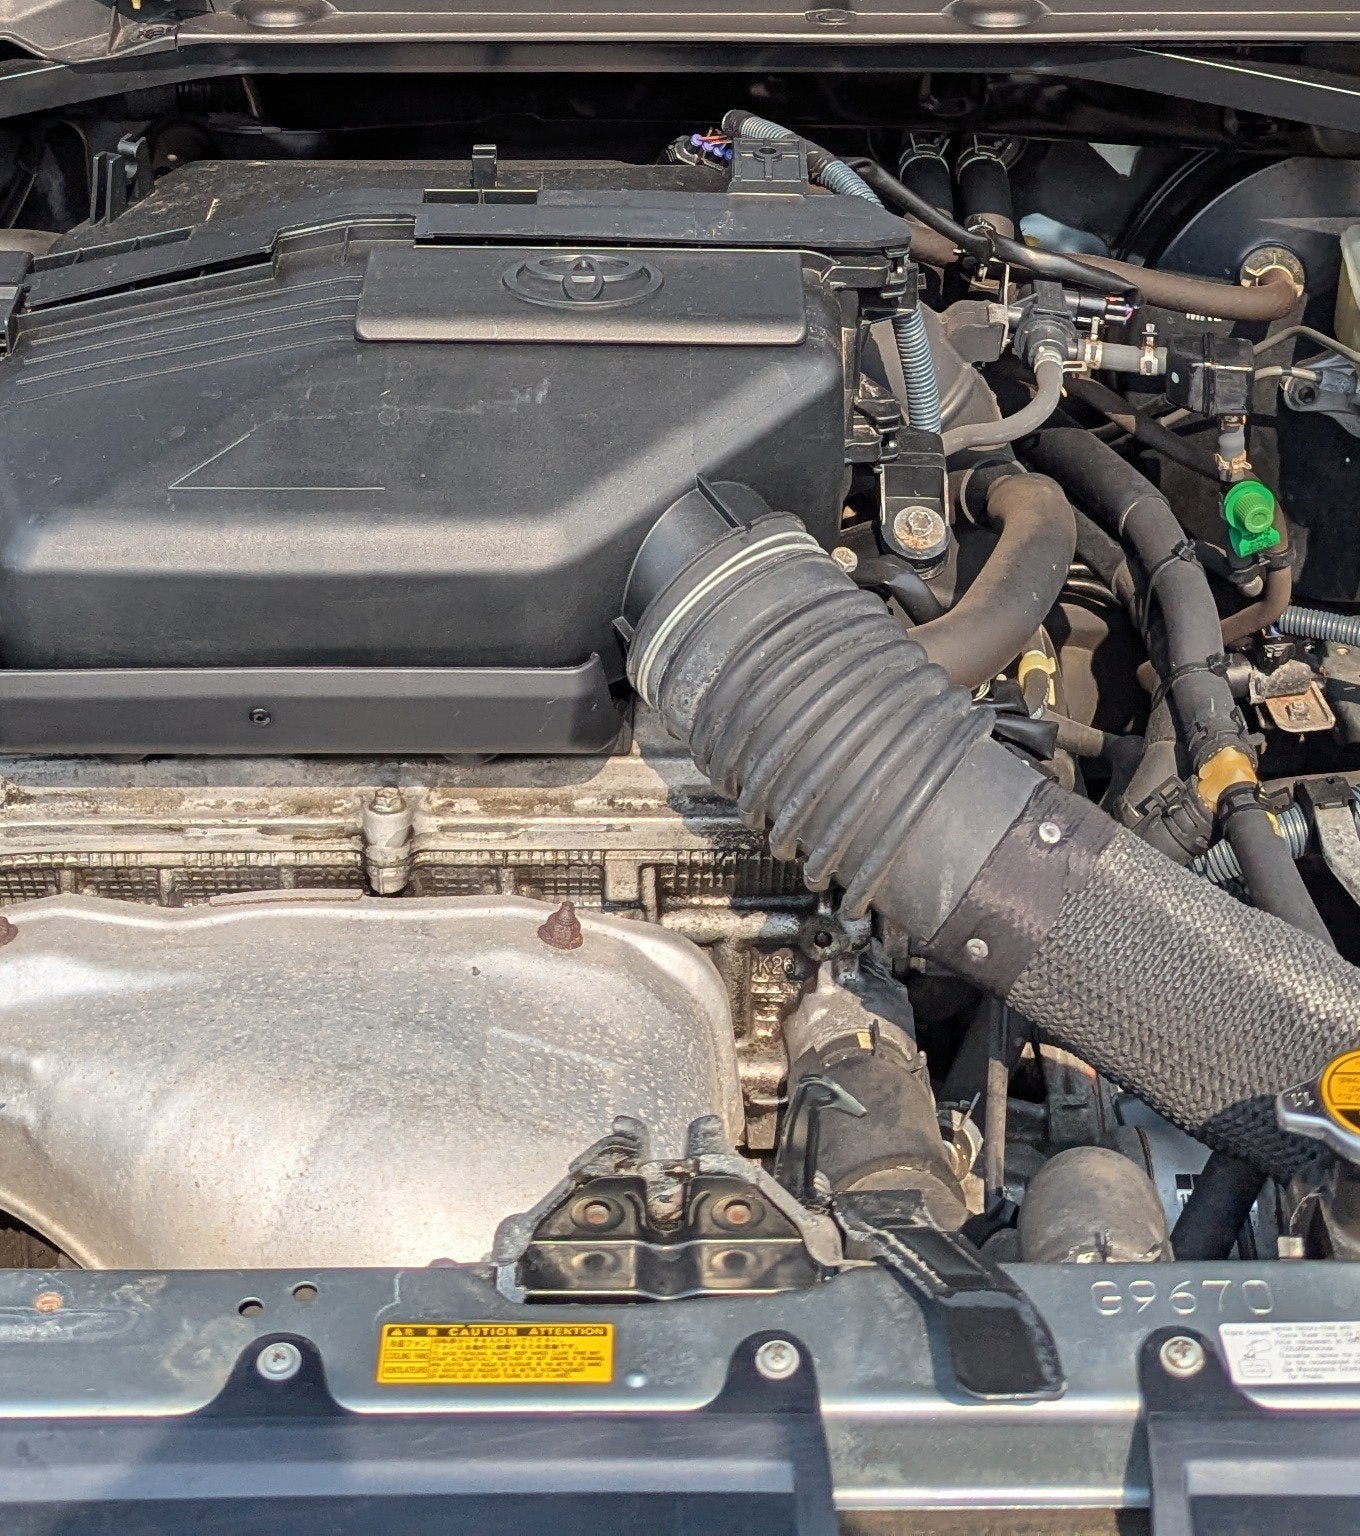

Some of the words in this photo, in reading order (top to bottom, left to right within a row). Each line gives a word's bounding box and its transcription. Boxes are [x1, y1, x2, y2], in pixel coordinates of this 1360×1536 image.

[1090, 1280, 1275, 1316] G9670
[448, 1327, 518, 1336] CAUTION
[528, 1327, 605, 1336] ATTENTION
